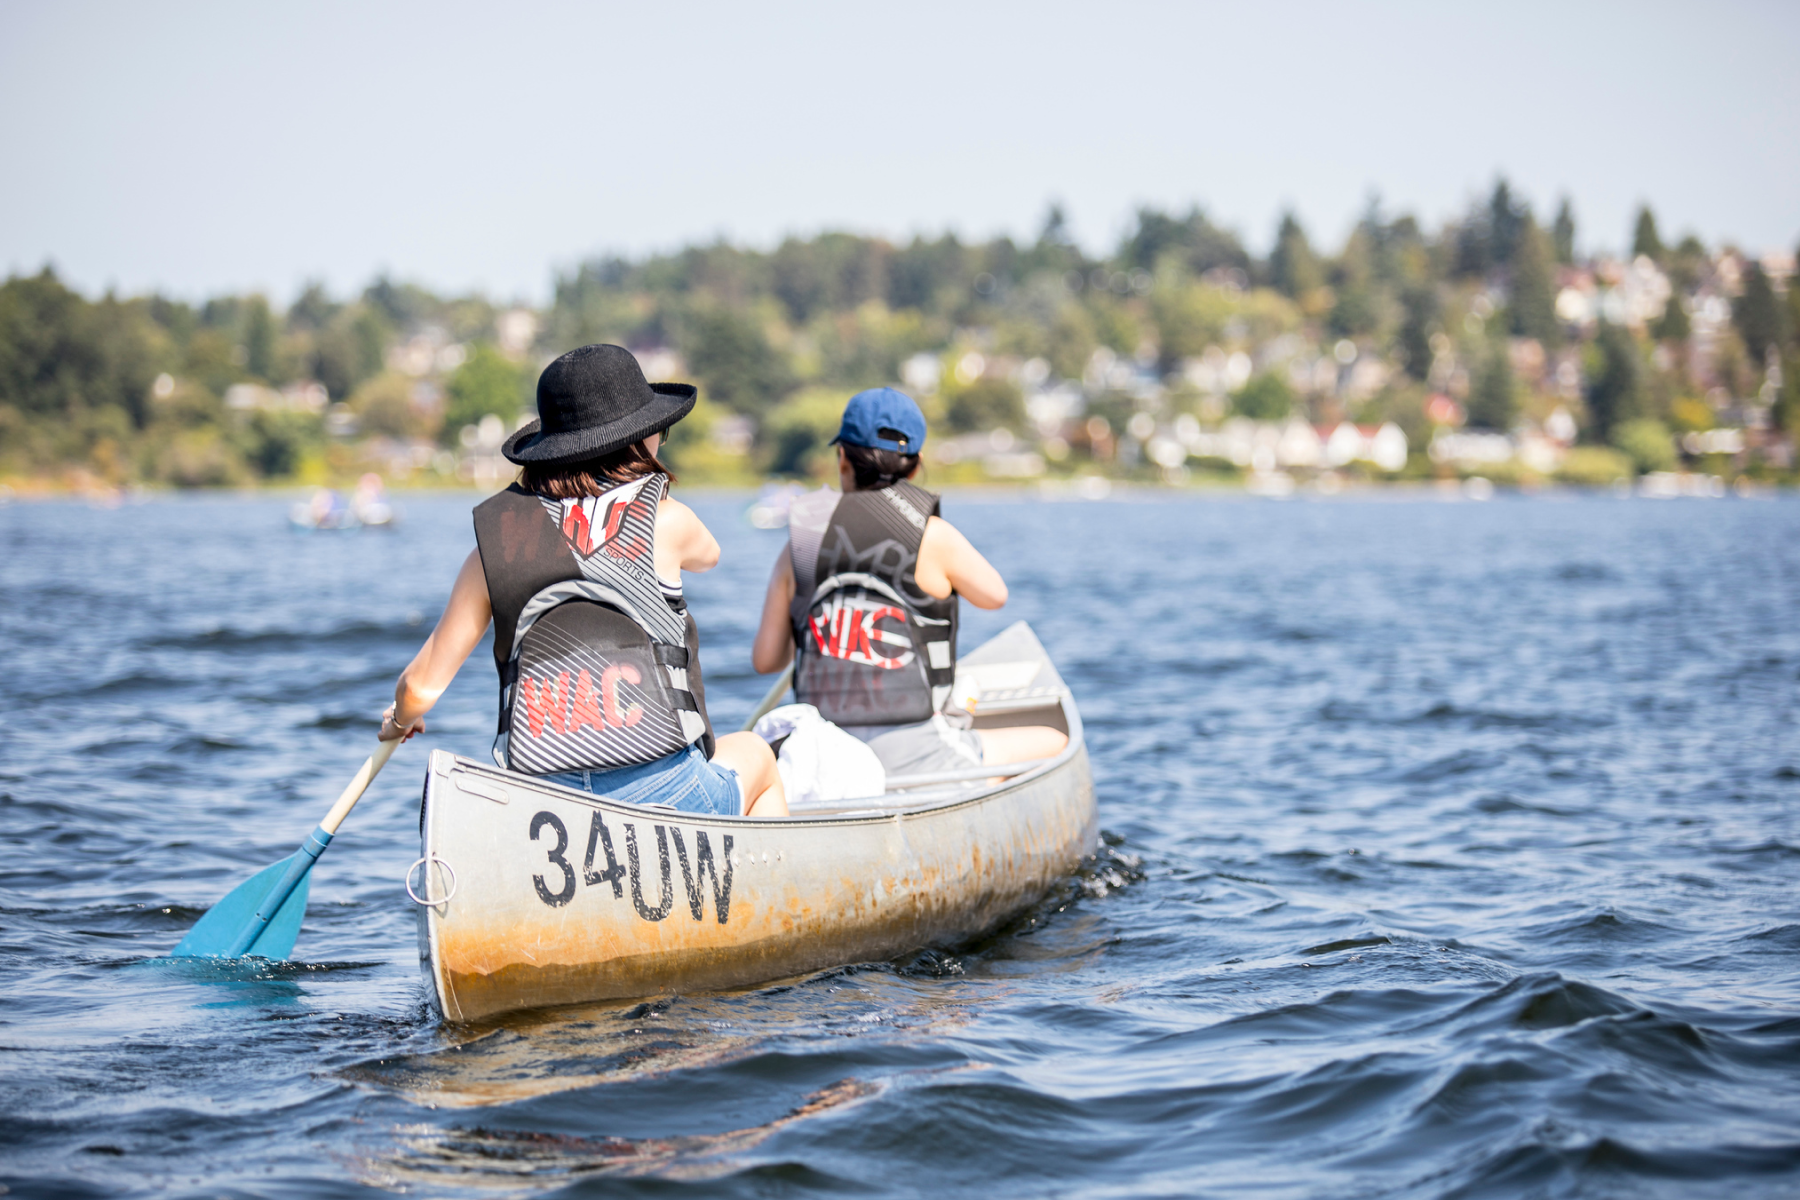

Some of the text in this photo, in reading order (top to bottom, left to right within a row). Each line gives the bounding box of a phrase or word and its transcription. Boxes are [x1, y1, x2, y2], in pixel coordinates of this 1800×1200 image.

[603, 547, 645, 581] SPORTS
[524, 662, 643, 738] WAC
[529, 810, 734, 925] 34UW
